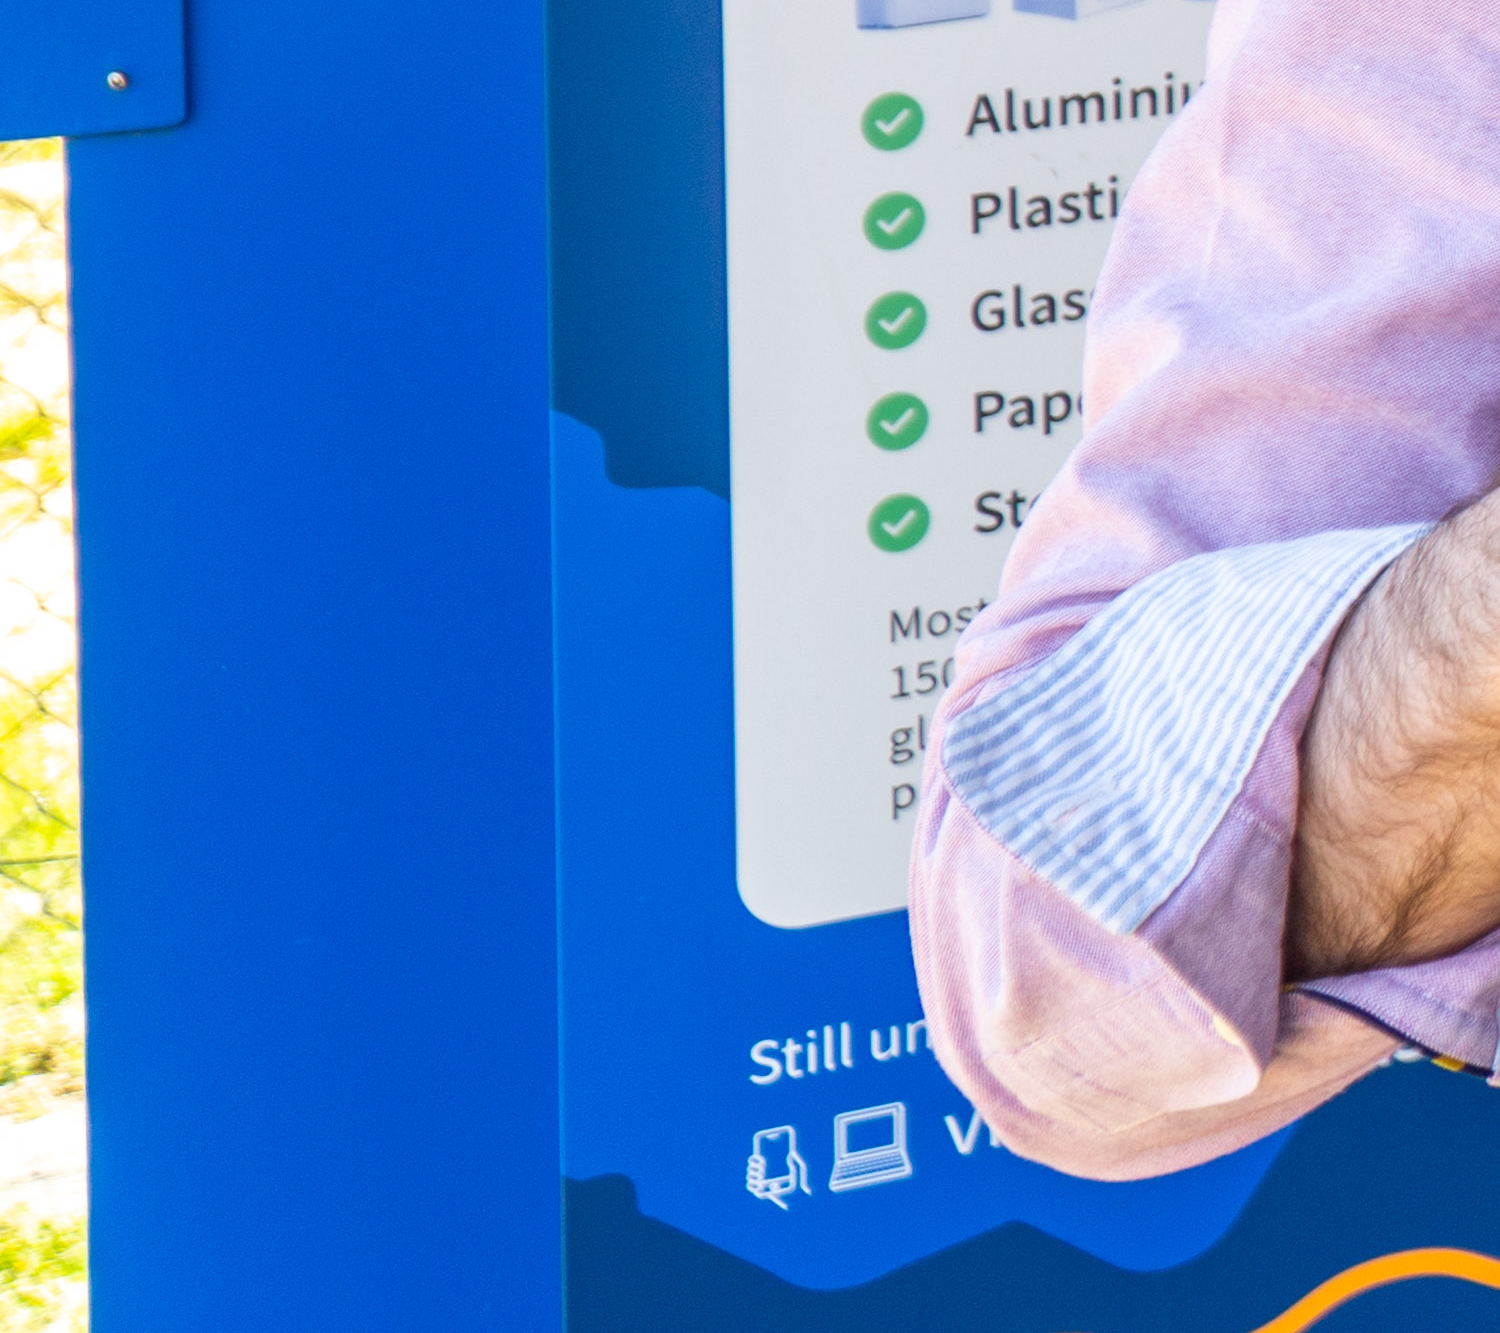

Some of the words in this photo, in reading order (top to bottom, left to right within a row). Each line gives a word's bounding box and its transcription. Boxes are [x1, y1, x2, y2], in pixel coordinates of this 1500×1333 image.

[970, 175, 1125, 236] Plasti
[970, 285, 1092, 334] Glas
[974, 488, 1036, 534] St
[748, 1021, 853, 1085] Still
